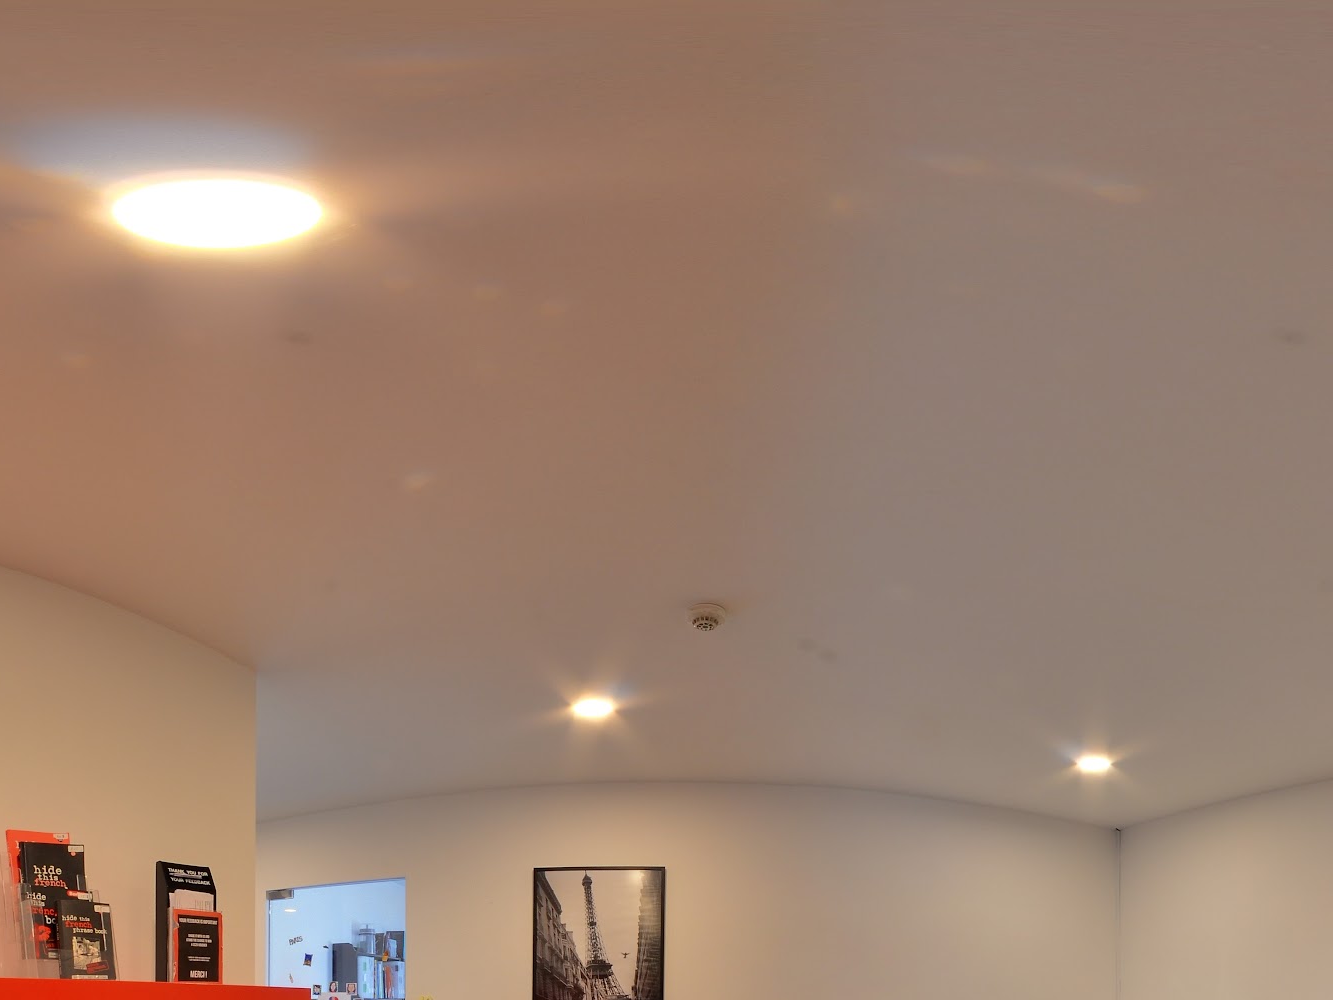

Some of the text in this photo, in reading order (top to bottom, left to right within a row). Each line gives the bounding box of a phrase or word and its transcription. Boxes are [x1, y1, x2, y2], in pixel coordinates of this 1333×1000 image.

[33, 865, 62, 875] hide
[37, 873, 59, 881] this
[34, 879, 67, 888] french
[185, 878, 211, 886] FEEDBACK
[65, 920, 93, 929] french
